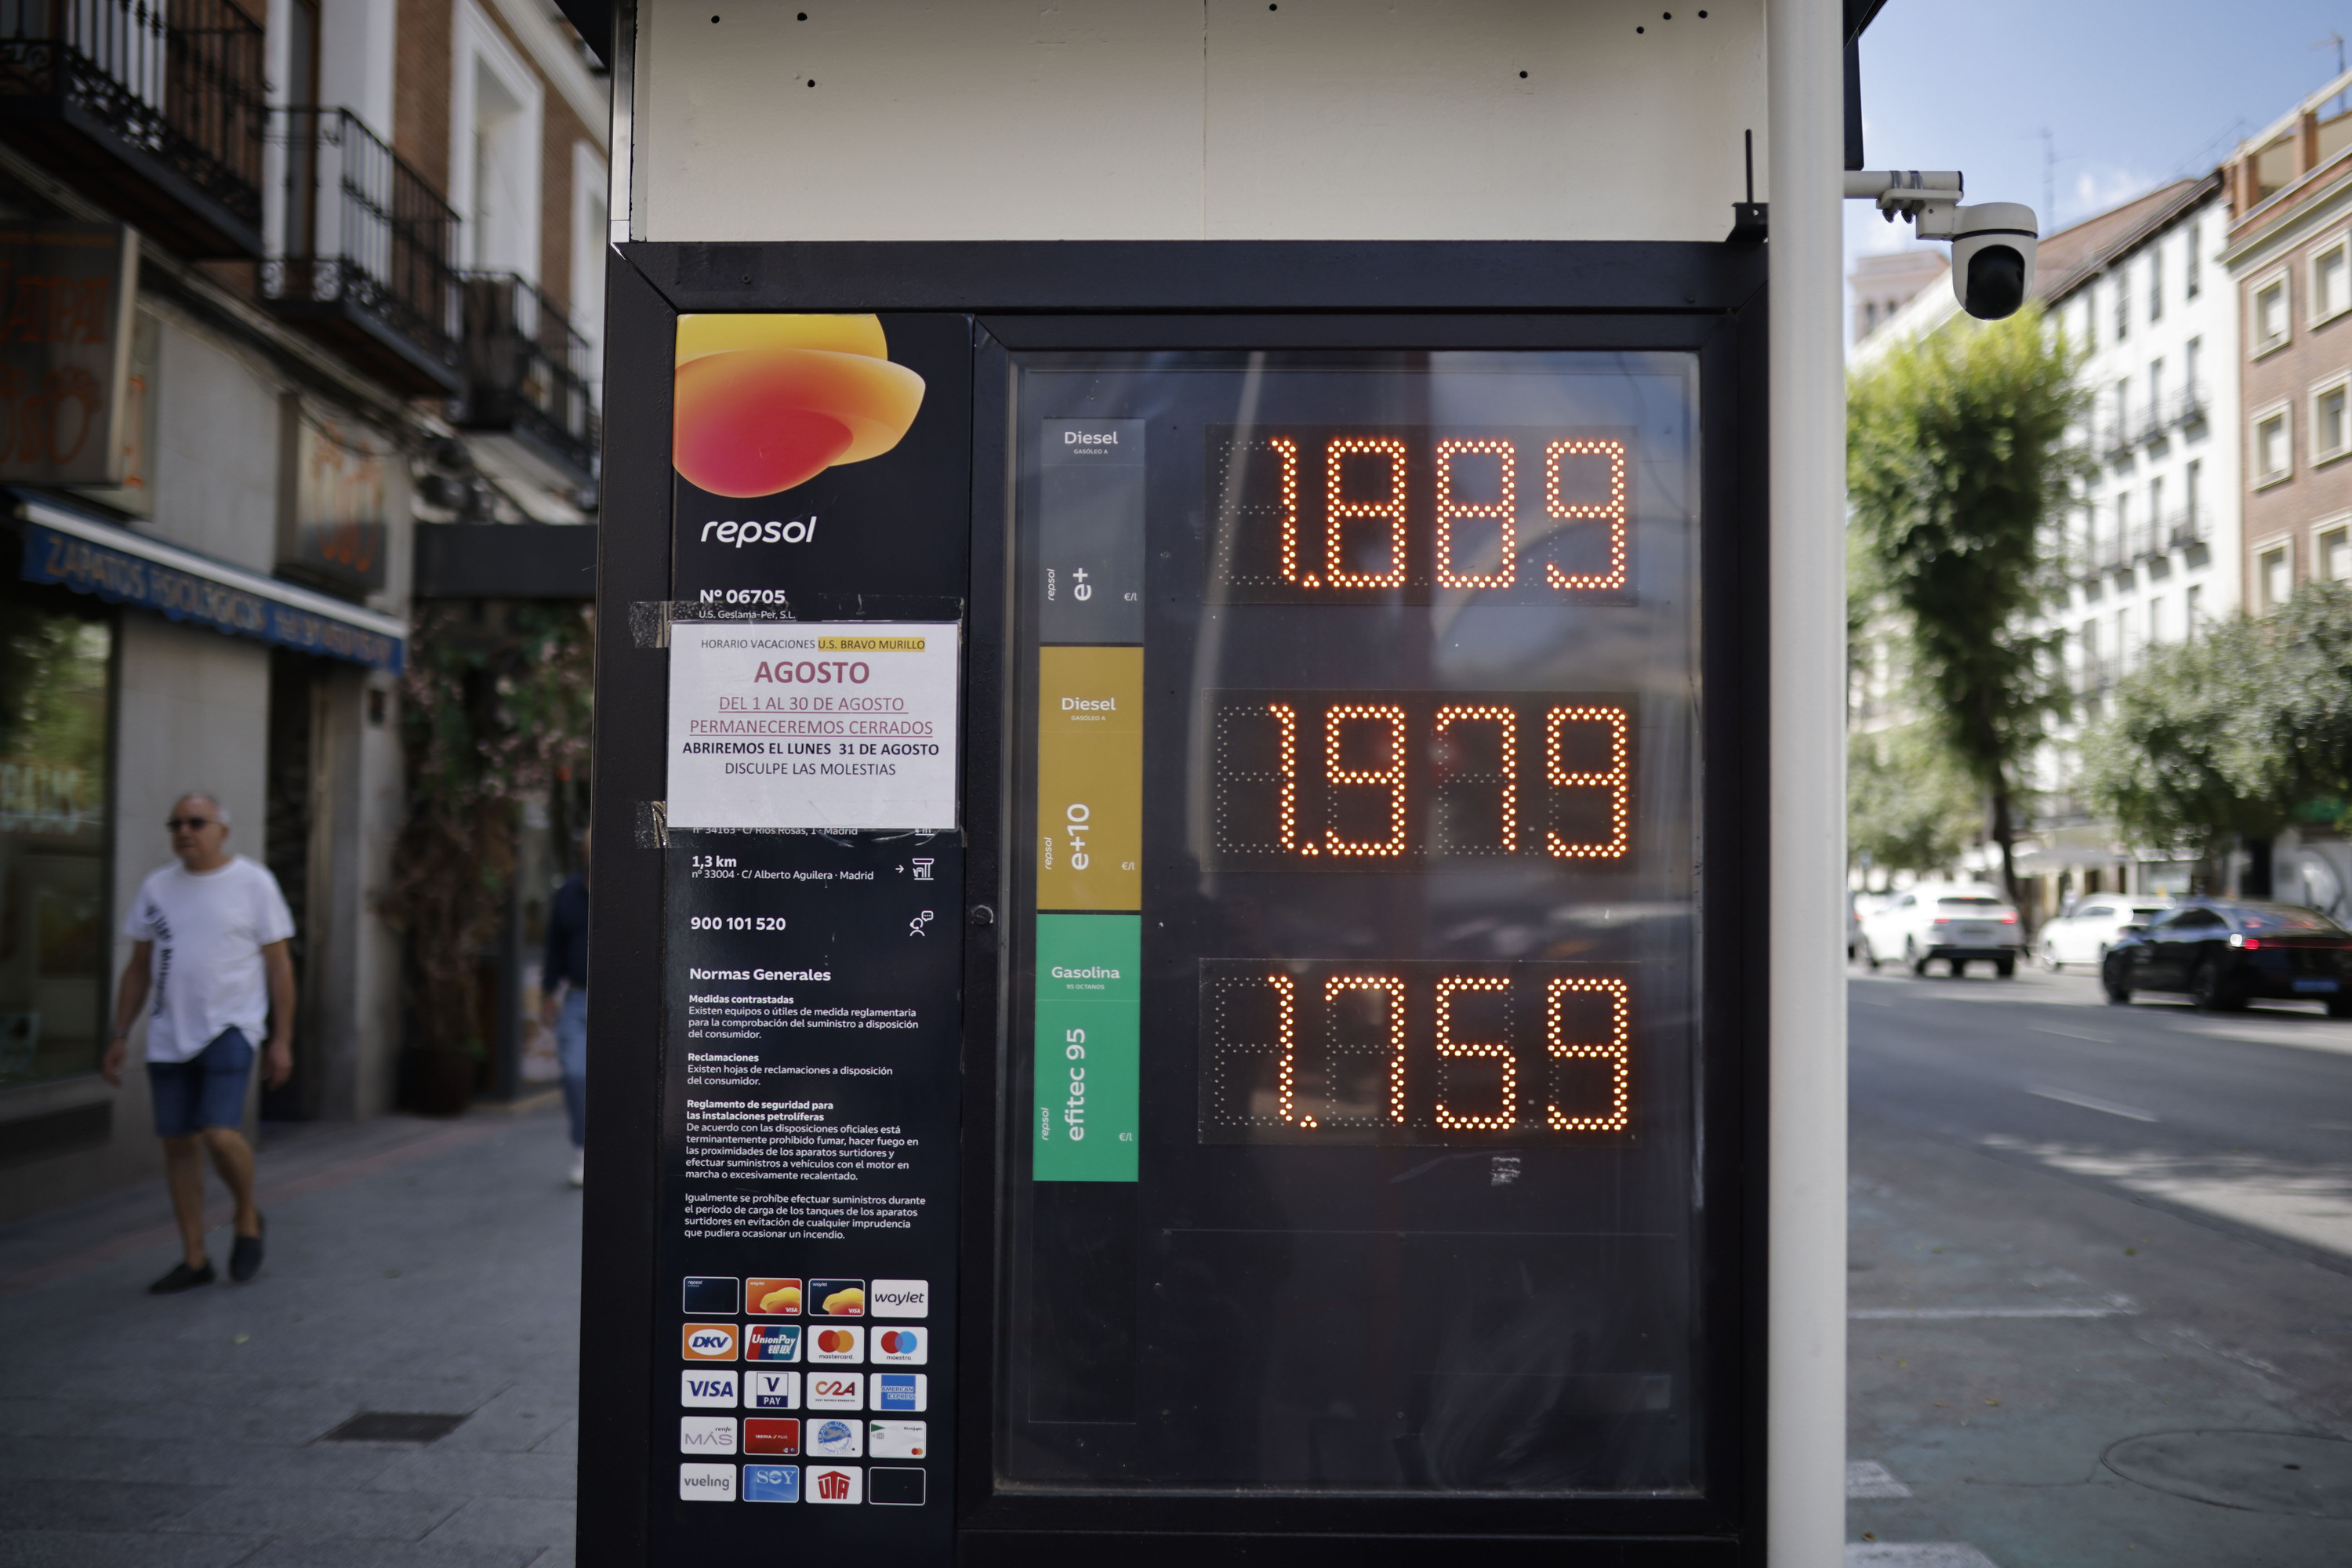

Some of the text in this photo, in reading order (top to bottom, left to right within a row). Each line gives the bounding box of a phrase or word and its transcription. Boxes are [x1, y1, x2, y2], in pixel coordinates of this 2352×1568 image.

[1064, 430, 1119, 445] Diesel
[1270, 440, 1625, 590] 1.889
[700, 516, 817, 548] repsol
[1046, 568, 1055, 601] repsol
[1073, 568, 1092, 601] e+
[699, 589, 787, 605] Nº 06705
[717, 610, 778, 619] Geslama-Per,
[701, 639, 925, 650] HORARIO VACACIONES U.S. BRAVO MURILLO
[753, 661, 869, 684] AGOSTO
[720, 696, 904, 711] DEL 1 AL 30 DE AGOSTO
[1062, 697, 1116, 710] Diesel
[690, 720, 933, 735] PERMANECEREMOS CERRADOS
[682, 742, 939, 756] ABRIREMOS EL LUNES 31 DE AGOSTO
[725, 762, 895, 775] DISCULPE LAS MOLESTIAS
[1269, 706, 1628, 858] 1.979
[824, 827, 858, 836] Madrid
[1066, 803, 1090, 870] e+10
[1044, 837, 1053, 870] repsol
[691, 855, 737, 870] 1,3 km
[691, 869, 873, 882] nº 33004 C/ Alberto Aguilera Madrid
[690, 916, 786, 931] 900 101 520
[690, 967, 831, 981] Normas Generales
[1051, 966, 1120, 978] Gasolina
[688, 993, 794, 1004] Medidas contrastadas
[688, 1006, 723, 1015] Existen
[724, 1006, 762, 1018] equipos
[771, 1007, 798, 1016] útiles
[800, 1007, 812, 1016] de
[814, 1007, 849, 1017] medida
[851, 1007, 916, 1019] reglamentaria
[688, 1019, 709, 1029] para
[711, 1018, 720, 1027] la
[721, 1018, 788, 1029] comprobación
[789, 1018, 805, 1028] del
[807, 1018, 856, 1028] suministro
[866, 1019, 919, 1031] disposición
[688, 1029, 761, 1039] del consumidor.
[688, 1052, 759, 1062] Reclamaciones
[1268, 976, 1628, 1131] 1.759
[687, 1064, 721, 1074] Existen
[723, 1065, 748, 1076] hojas
[750, 1065, 762, 1074] de
[764, 1065, 831, 1075] reclamaciones
[840, 1065, 893, 1077] disposición
[1065, 1028, 1085, 1142] efitec 95
[687, 1099, 833, 1112] Reglamento de seguridad para
[686, 1110, 825, 1123] las instalaciones petrolíferas
[686, 1123, 699, 1132] De
[701, 1123, 739, 1132] acuerdo
[760, 1123, 774, 1133] las
[775, 1123, 839, 1135] disposiciones
[840, 1124, 879, 1134] oficiales
[880, 1125, 901, 1134] está
[1040, 1107, 1050, 1141] repsol
[685, 1168, 720, 1178] marcha
[729, 1169, 798, 1179] excesivamente
[800, 1170, 858, 1179] recalentado.
[685, 1193, 739, 1205] Igualmente
[752, 1194, 789, 1206] prohíbe
[790, 1194, 830, 1204] efectuar
[832, 1195, 887, 1204] suministros
[887, 1195, 926, 1205] durante
[874, 1291, 925, 1306] waylet
[692, 1336, 730, 1348] DKV
[751, 1334, 797, 1347] UnionPay
[768, 1345, 791, 1355] 银联
[686, 1380, 734, 1397] VISA
[763, 1377, 781, 1392] V
[764, 1396, 782, 1406] PAY
[685, 1431, 733, 1446] MÁS
[684, 1475, 730, 1490] vueling
[757, 1470, 797, 1485] SOY
[817, 1470, 851, 1500] UTA
